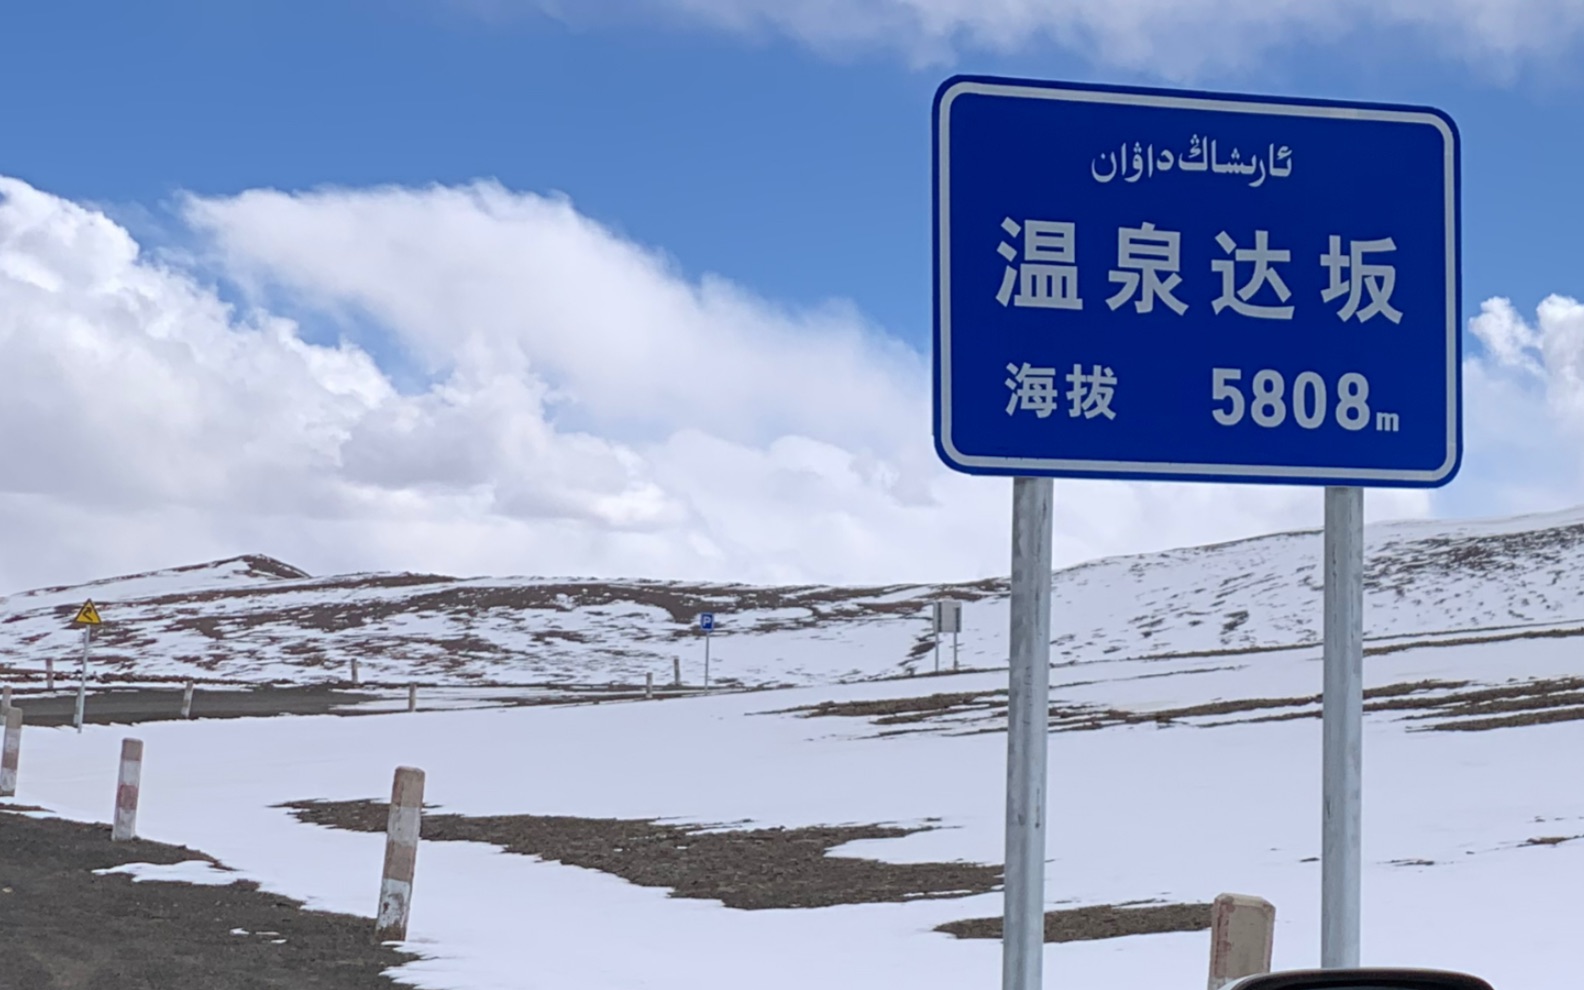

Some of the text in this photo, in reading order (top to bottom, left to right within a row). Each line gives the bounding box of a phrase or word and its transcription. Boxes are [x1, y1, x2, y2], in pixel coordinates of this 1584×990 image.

[995, 216, 1404, 324] 温泉达坂
[1004, 362, 1118, 420] 海拔
